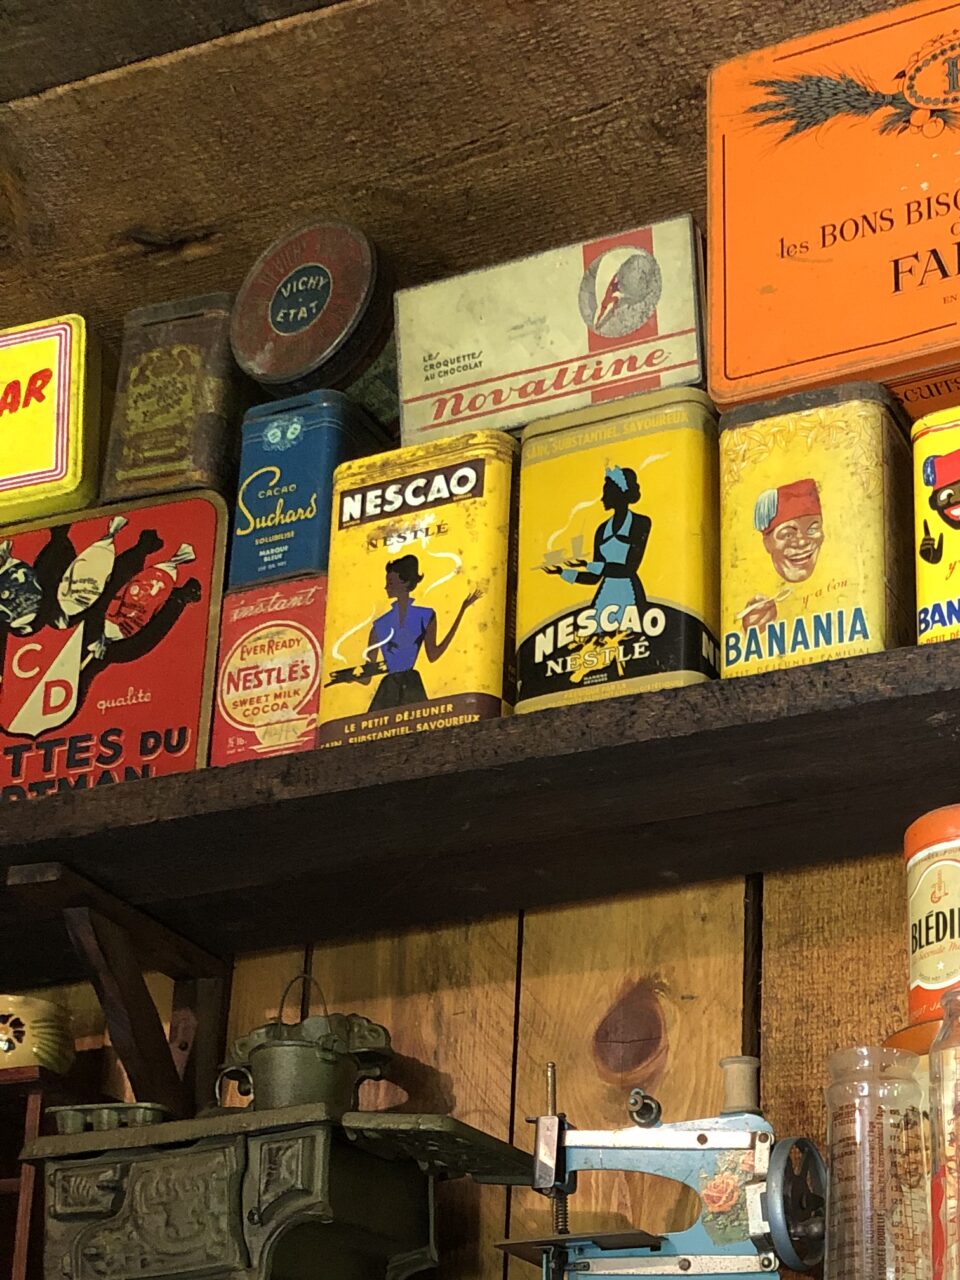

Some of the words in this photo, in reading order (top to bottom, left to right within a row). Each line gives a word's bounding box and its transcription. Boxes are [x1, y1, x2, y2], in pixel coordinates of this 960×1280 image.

[779, 237, 809, 260] les
[820, 207, 895, 250] BONS
[281, 275, 328, 298] VICHY
[943, 294, 958, 304] EN
[276, 301, 318, 322] ETAT
[423, 352, 439, 362] LES
[423, 351, 483, 372] CROQUETTES
[424, 373, 436, 382] AU
[437, 361, 483, 379] CHOCOLAT
[236, 465, 317, 536] Suchard
[258, 484, 297, 498] CACAO
[341, 466, 477, 523] NESCAO
[366, 519, 449, 551] NESTLÉ
[229, 586, 323, 623] instant
[534, 604, 666, 664] NESCAO
[725, 607, 870, 668] BANANIA
[11, 642, 43, 679] C
[545, 635, 650, 677] NESTLÉ
[42, 679, 74, 717] D
[232, 693, 271, 710] SWEET
[273, 687, 301, 700] MILK
[242, 702, 289, 718] COCOA
[344, 723, 356, 734] LE
[361, 716, 390, 731] PETIT
[395, 703, 454, 722] DÉJEUNER
[416, 714, 480, 733] SAVOUREUX
[140, 725, 192, 760] DU
